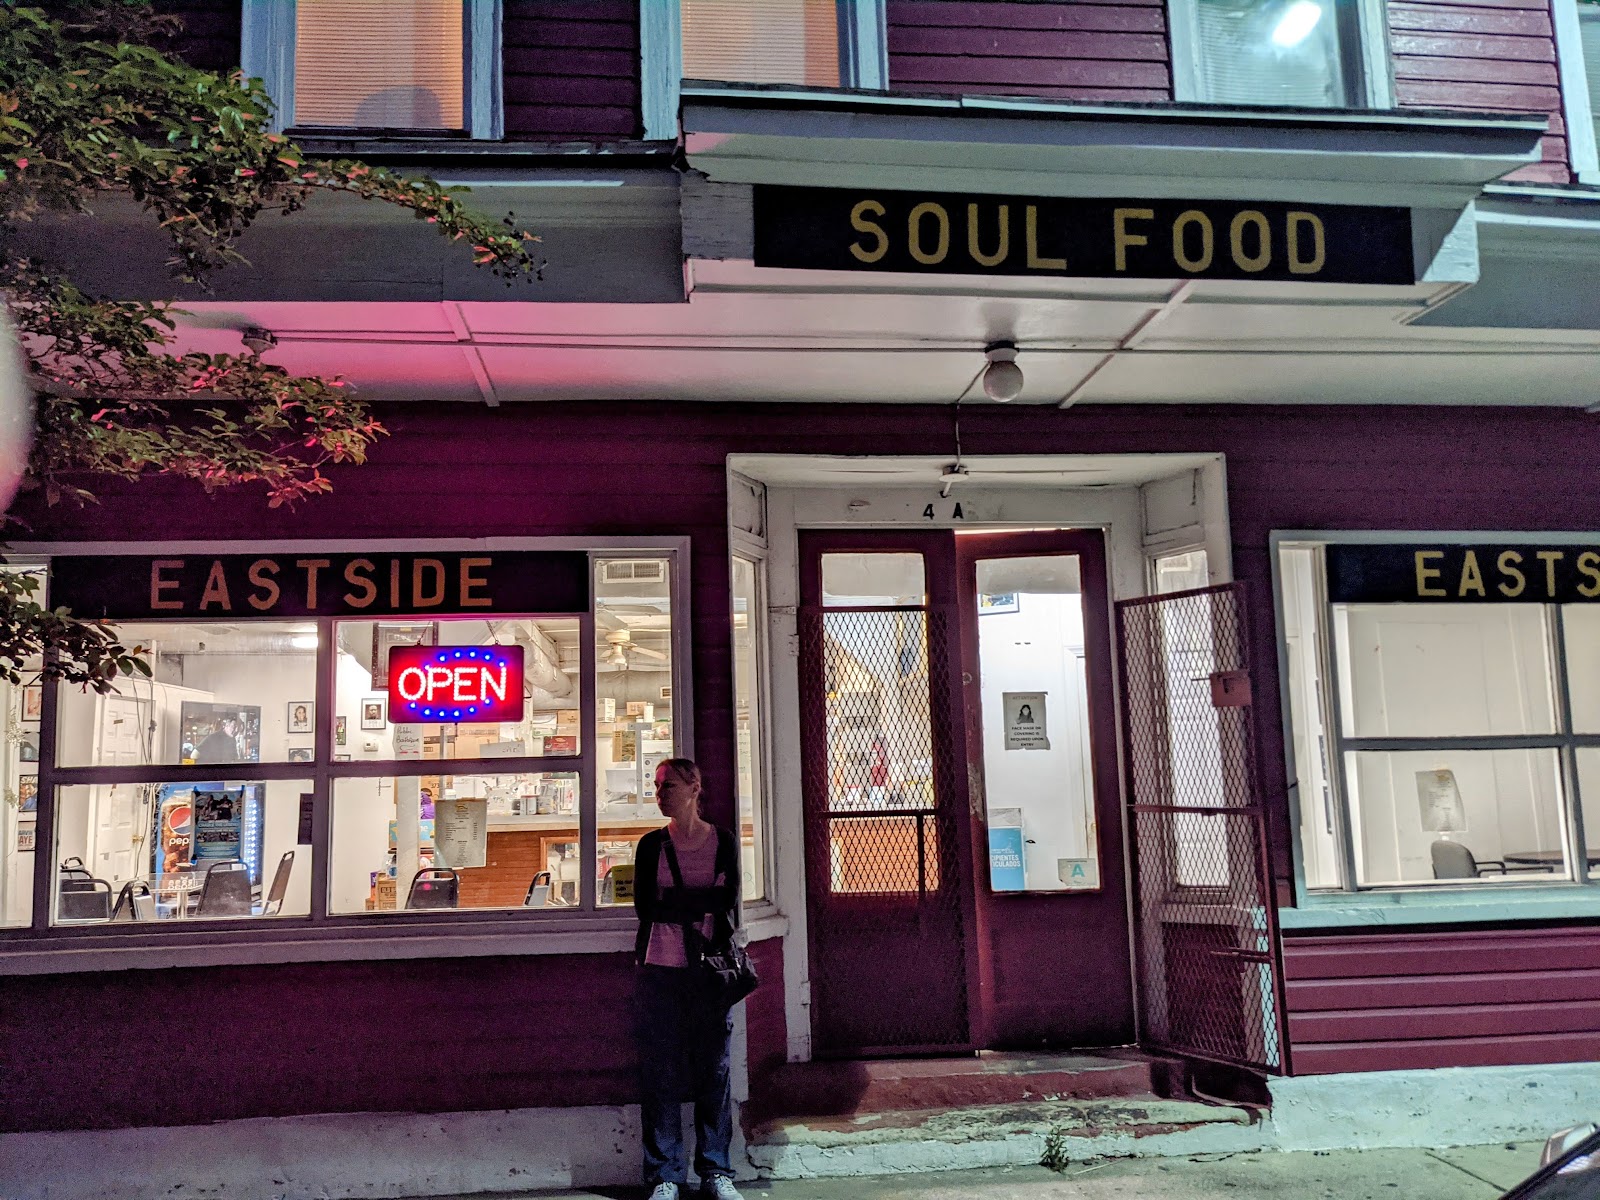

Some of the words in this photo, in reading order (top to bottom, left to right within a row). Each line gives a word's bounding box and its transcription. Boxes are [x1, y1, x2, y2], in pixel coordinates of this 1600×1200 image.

[849, 199, 1068, 271] SOUL
[1113, 207, 1327, 275] FOOD
[922, 503, 935, 520] 4
[952, 502, 964, 519] A
[149, 557, 493, 611] EASTSIDE
[1413, 549, 1600, 598] EASTS
[397, 666, 507, 701] OPEN
[1070, 863, 1085, 878] A
